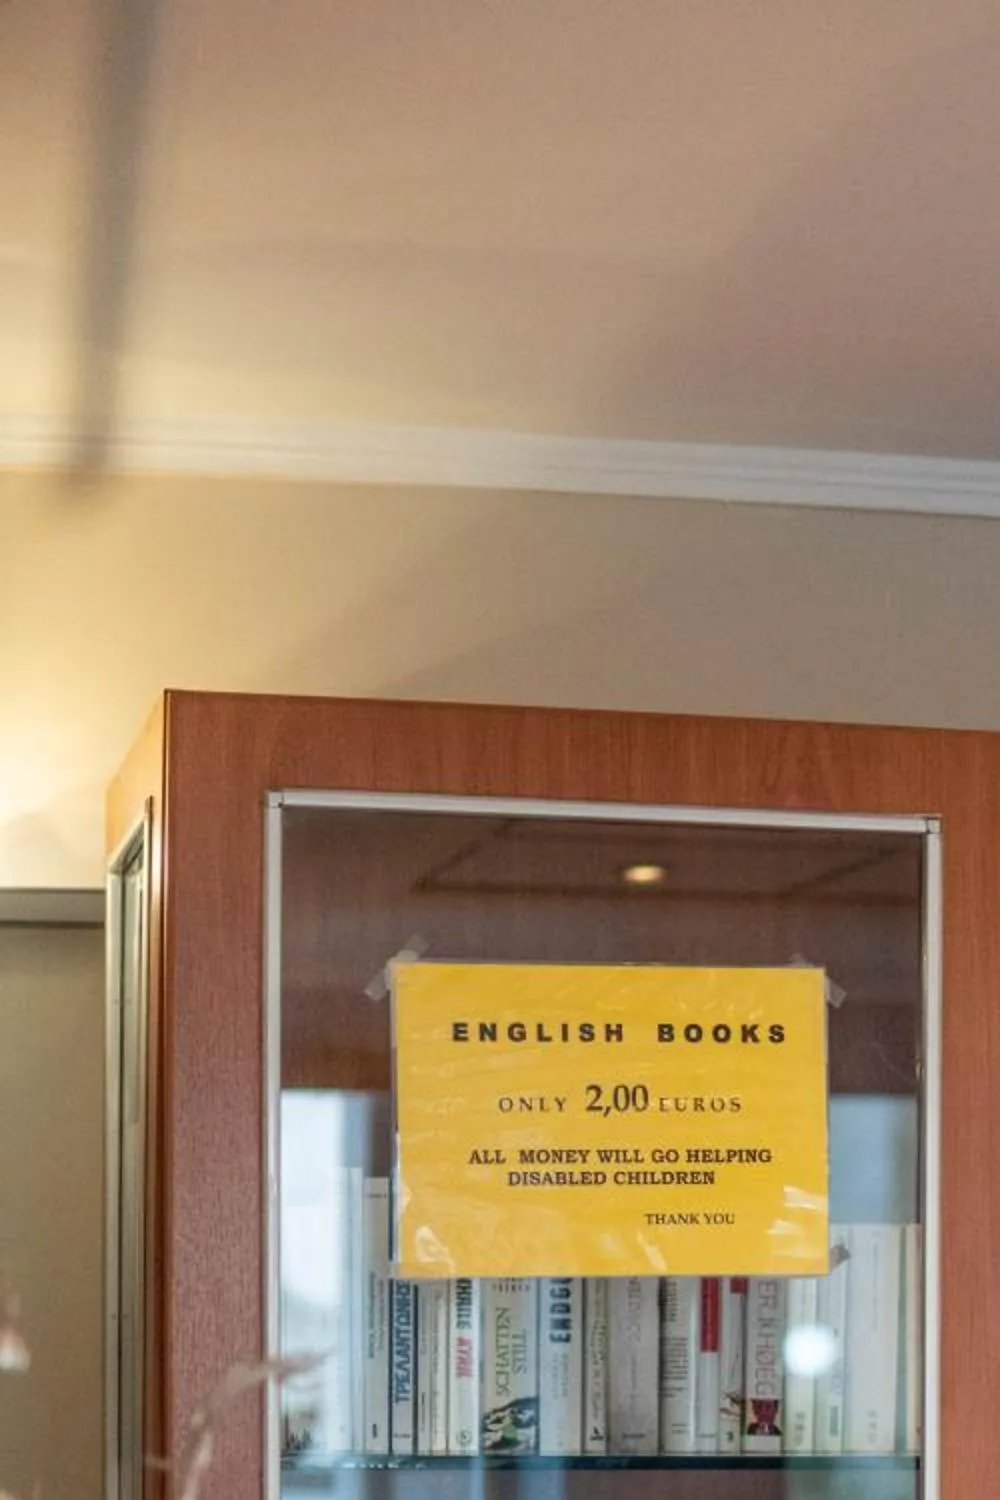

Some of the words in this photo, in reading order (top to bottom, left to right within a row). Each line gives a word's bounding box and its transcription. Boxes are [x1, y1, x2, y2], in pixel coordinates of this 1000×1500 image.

[452, 1022, 624, 1043] ENGLISH
[657, 1023, 787, 1044] BOOKS
[498, 1096, 568, 1114] ONLY
[585, 1084, 649, 1118] 2,00
[657, 1096, 743, 1114] EUROS
[468, 1149, 506, 1165] ALL
[518, 1149, 590, 1165] MONEY
[596, 1149, 644, 1164] WILL
[651, 1149, 679, 1164] GO
[685, 1148, 772, 1164] HELPING
[507, 1170, 606, 1186] DISABLED
[613, 1170, 715, 1186] CHILDREN
[645, 1213, 700, 1226] THANK
[700, 1213, 736, 1226] YOU
[495, 1306, 512, 1399] SCHATTEN
[512, 1329, 528, 1376] STILL
